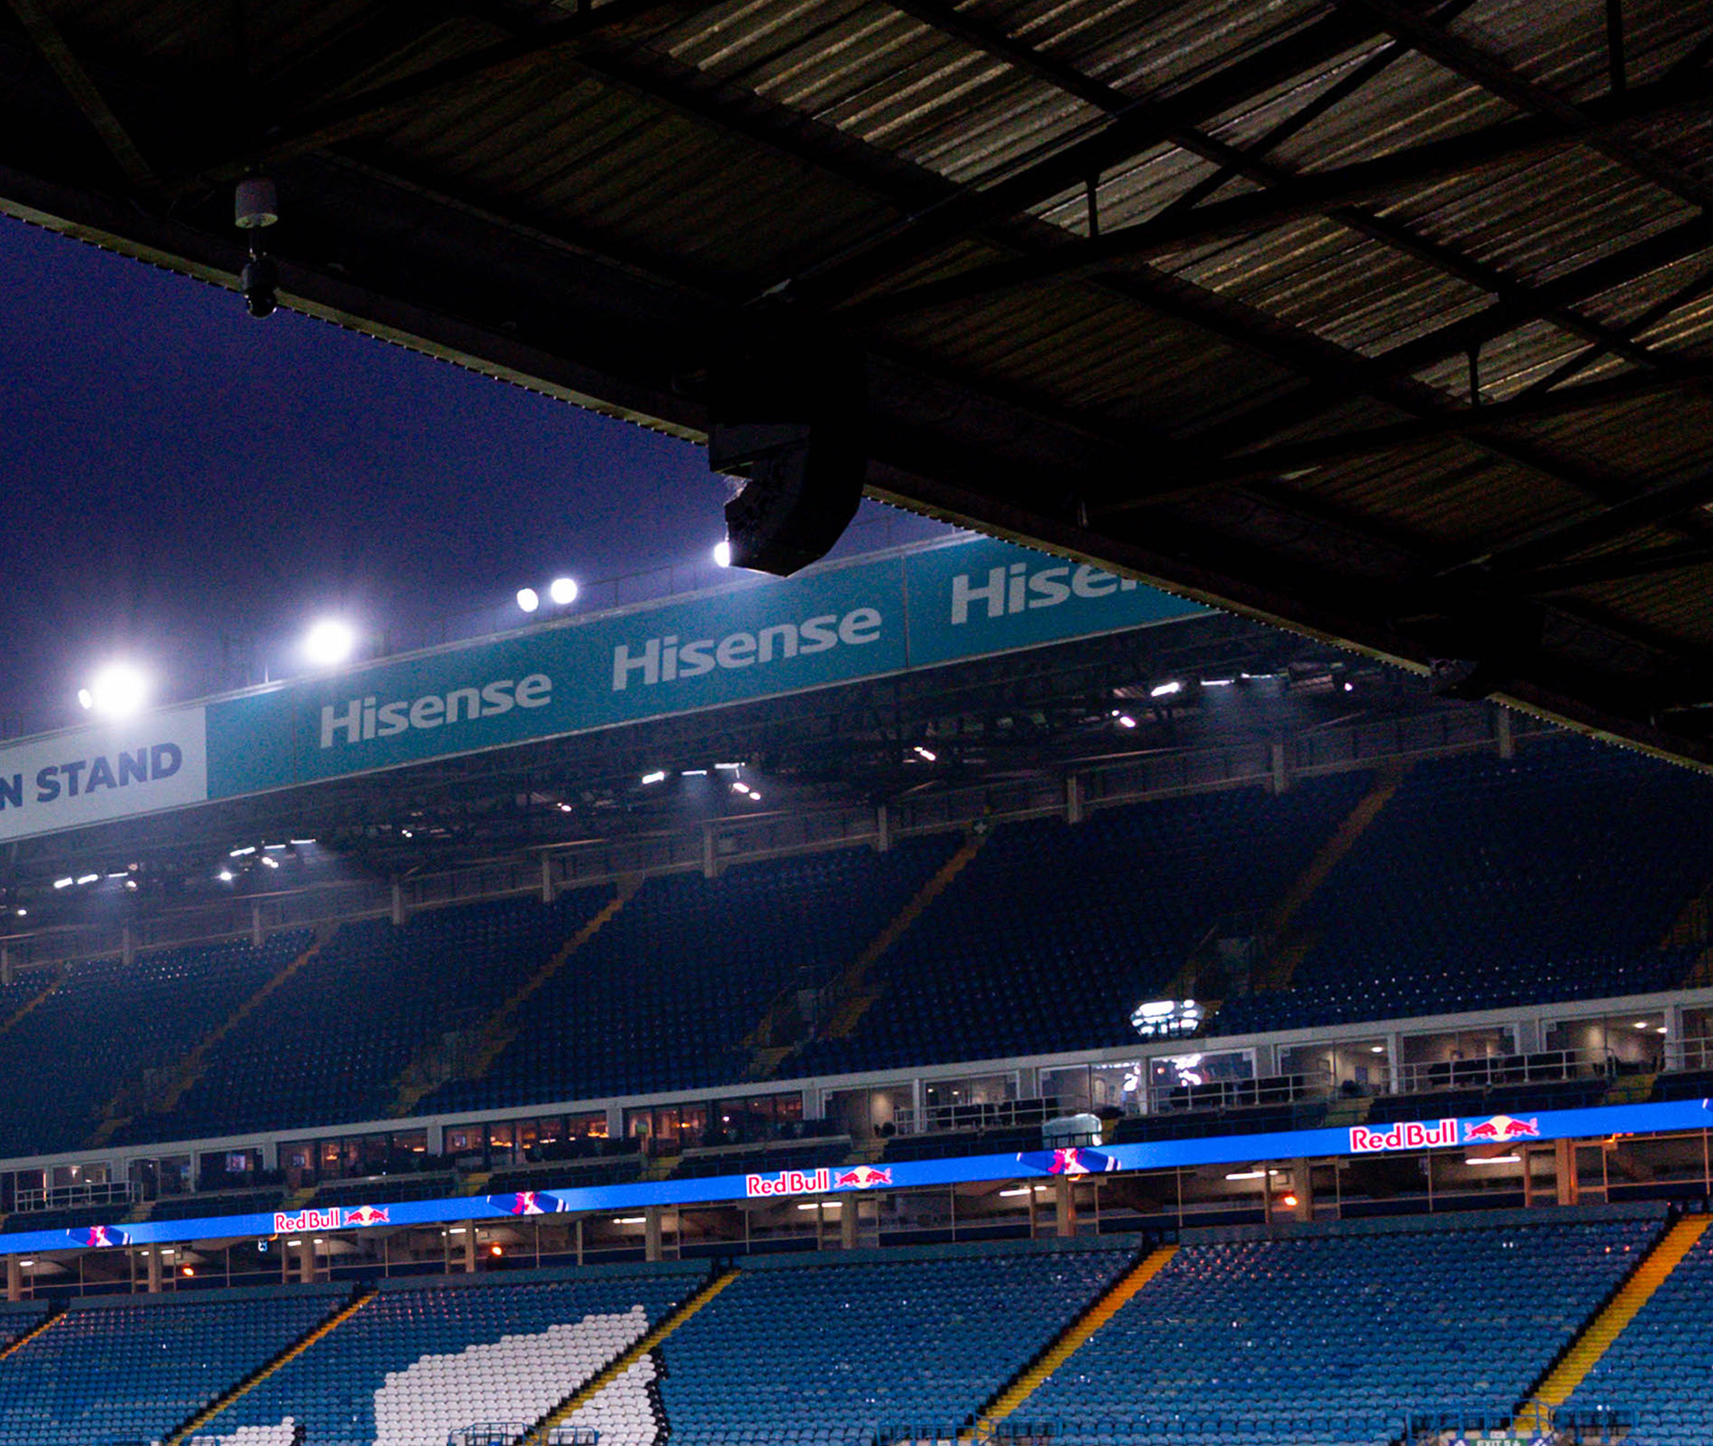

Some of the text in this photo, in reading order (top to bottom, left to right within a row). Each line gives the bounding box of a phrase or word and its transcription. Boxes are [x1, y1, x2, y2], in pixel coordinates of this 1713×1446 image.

[950, 562, 1137, 625] Hise
[611, 606, 882, 692] Hisense
[319, 671, 552, 749] Hisense
[35, 742, 183, 801] STAND
[1350, 1119, 1457, 1152] Red Bull
[746, 1168, 830, 1197] Red Bull
[274, 1207, 340, 1233] Red Bull
